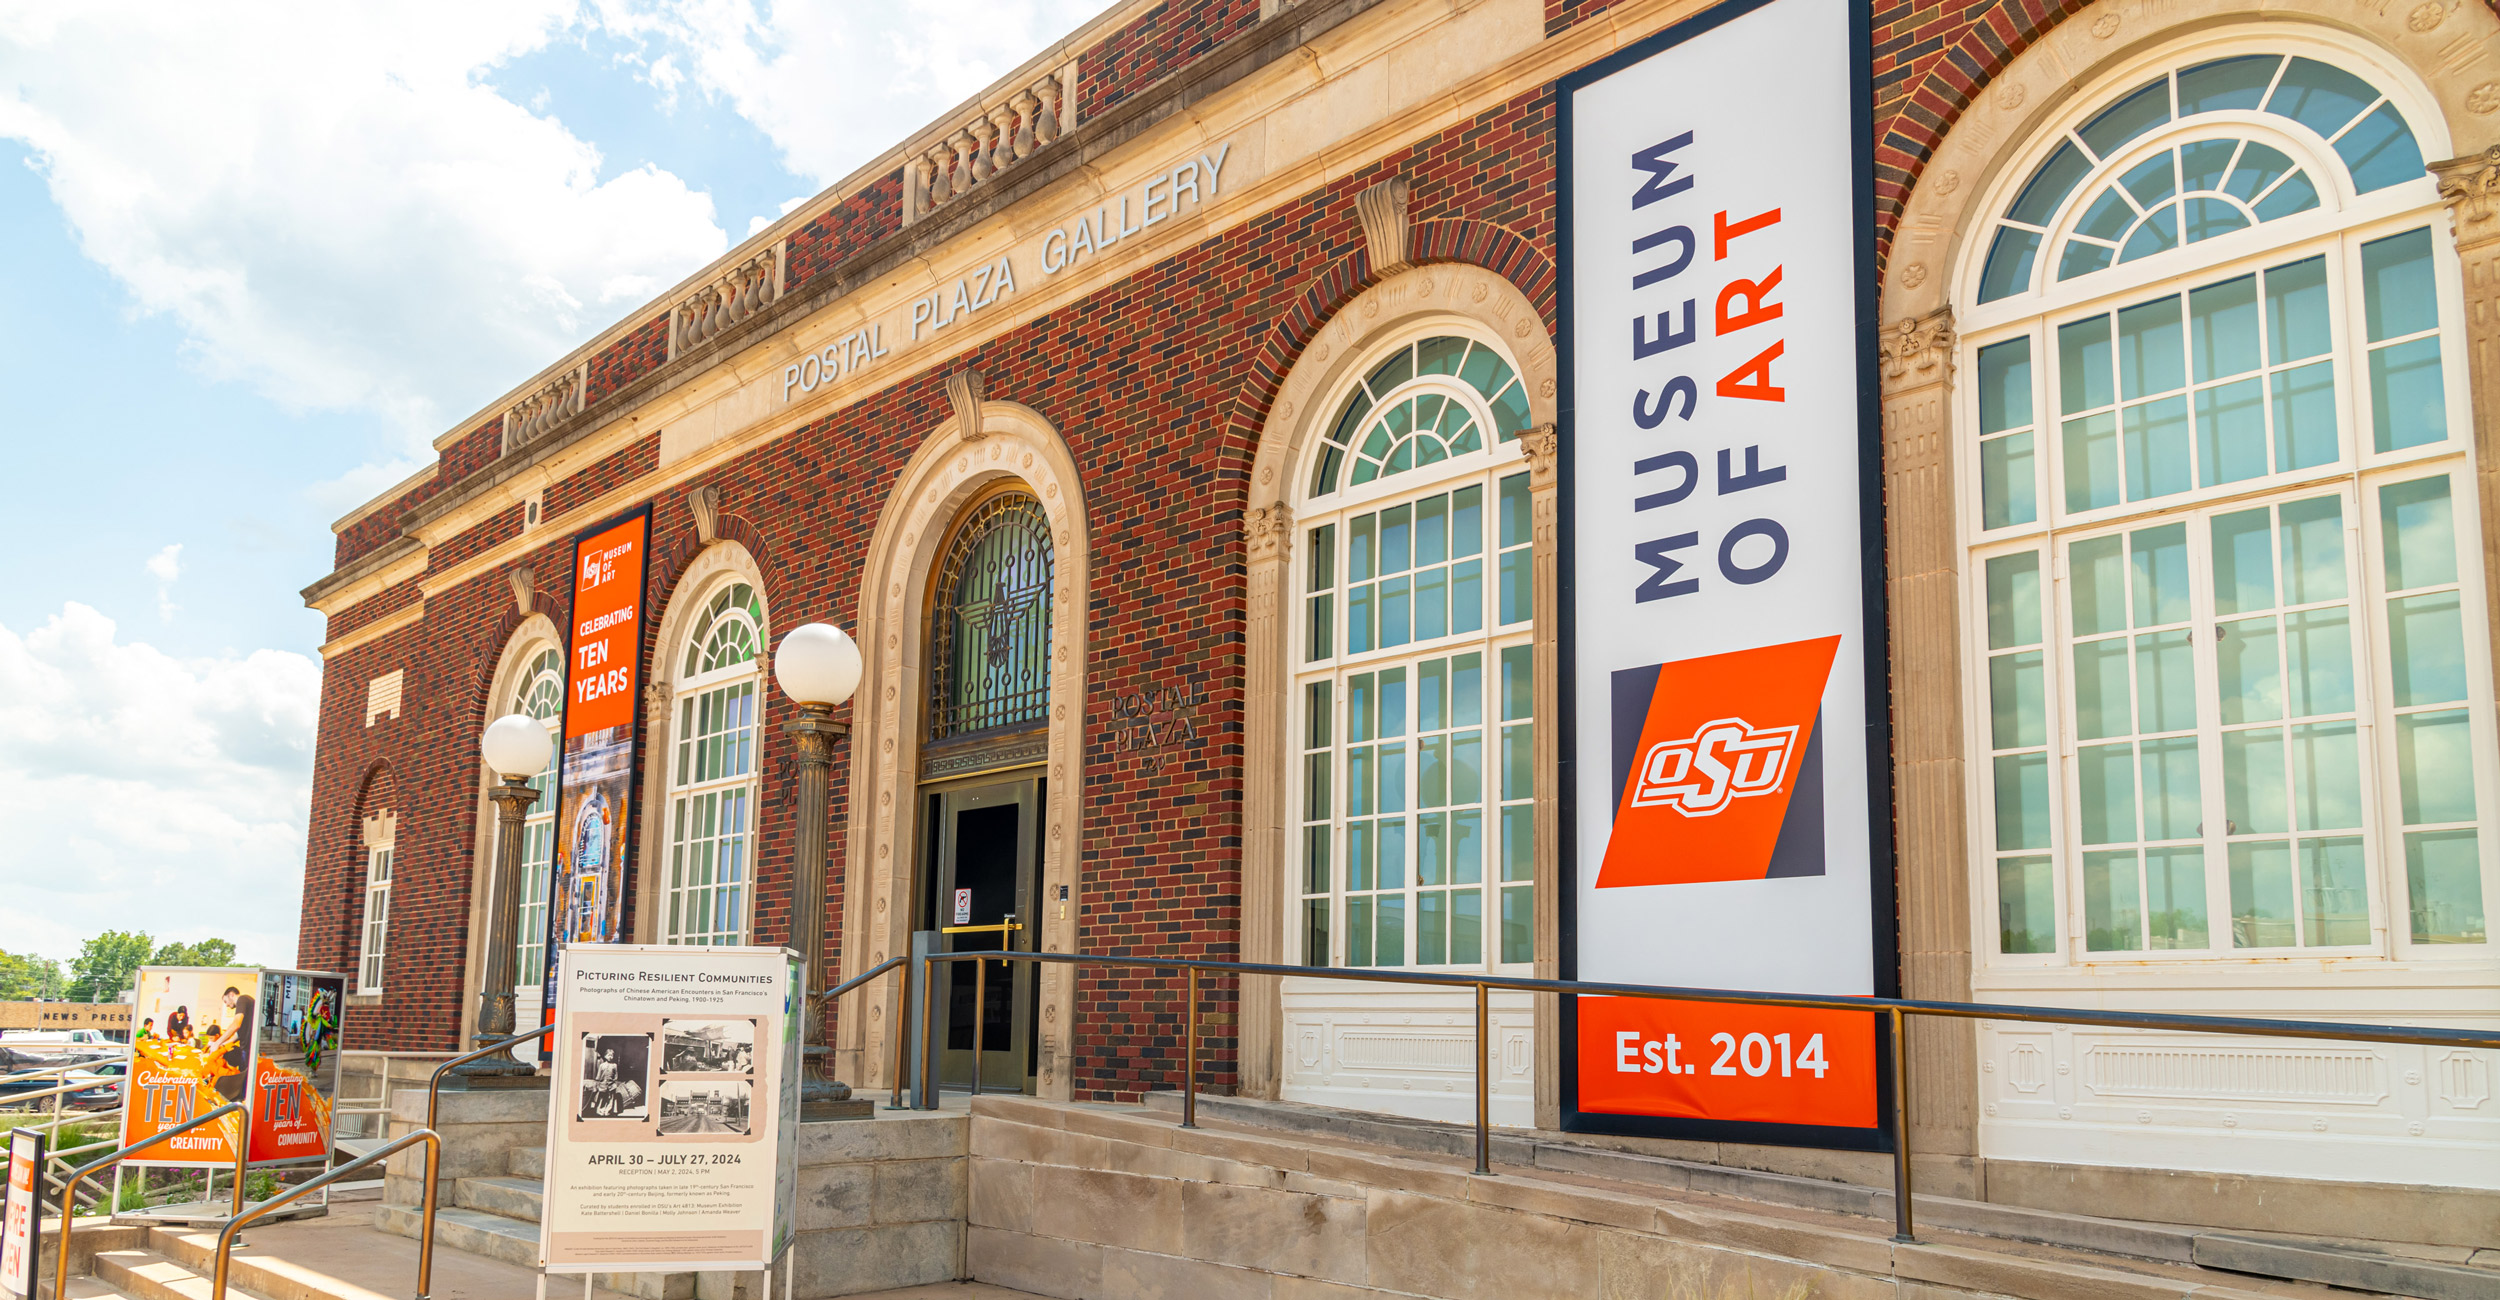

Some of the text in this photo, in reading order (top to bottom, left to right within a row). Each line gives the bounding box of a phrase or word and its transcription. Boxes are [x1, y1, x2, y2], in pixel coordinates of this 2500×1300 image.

[784, 142, 1229, 402] POSTAL PLAZA GALLERY
[1632, 129, 1700, 605] MUSEUM
[1713, 206, 1790, 585] OF ART
[602, 560, 613, 573] OF
[603, 540, 633, 562] MUSEUM
[601, 569, 616, 584] ART
[579, 605, 633, 637] CELEBRATING
[578, 638, 609, 670] TEN
[576, 666, 628, 704] YEARS
[1111, 682, 1206, 721] POSTAL
[1115, 715, 1197, 754] PLAZA
[1631, 717, 1800, 818] OSU
[576, 969, 773, 984] PICTURING RESILIENT COMMUNITIES
[43, 1012, 133, 1022] NEWS PRESS
[1615, 1031, 1830, 1079] Est. 2014
[137, 1070, 199, 1087] Celebrating
[259, 1070, 304, 1088] Celebrating
[142, 1084, 197, 1123] TEN
[263, 1083, 302, 1122] TEN
[273, 1120, 293, 1132] years
[277, 1131, 318, 1147] COMMUNITY
[170, 1136, 224, 1151] CREATIVITY
[588, 1154, 625, 1165] APRIL
[629, 1154, 644, 1165] 30
[657, 1154, 687, 1165] JULY
[690, 1154, 708, 1166] 27,
[711, 1153, 742, 1165] 2024
